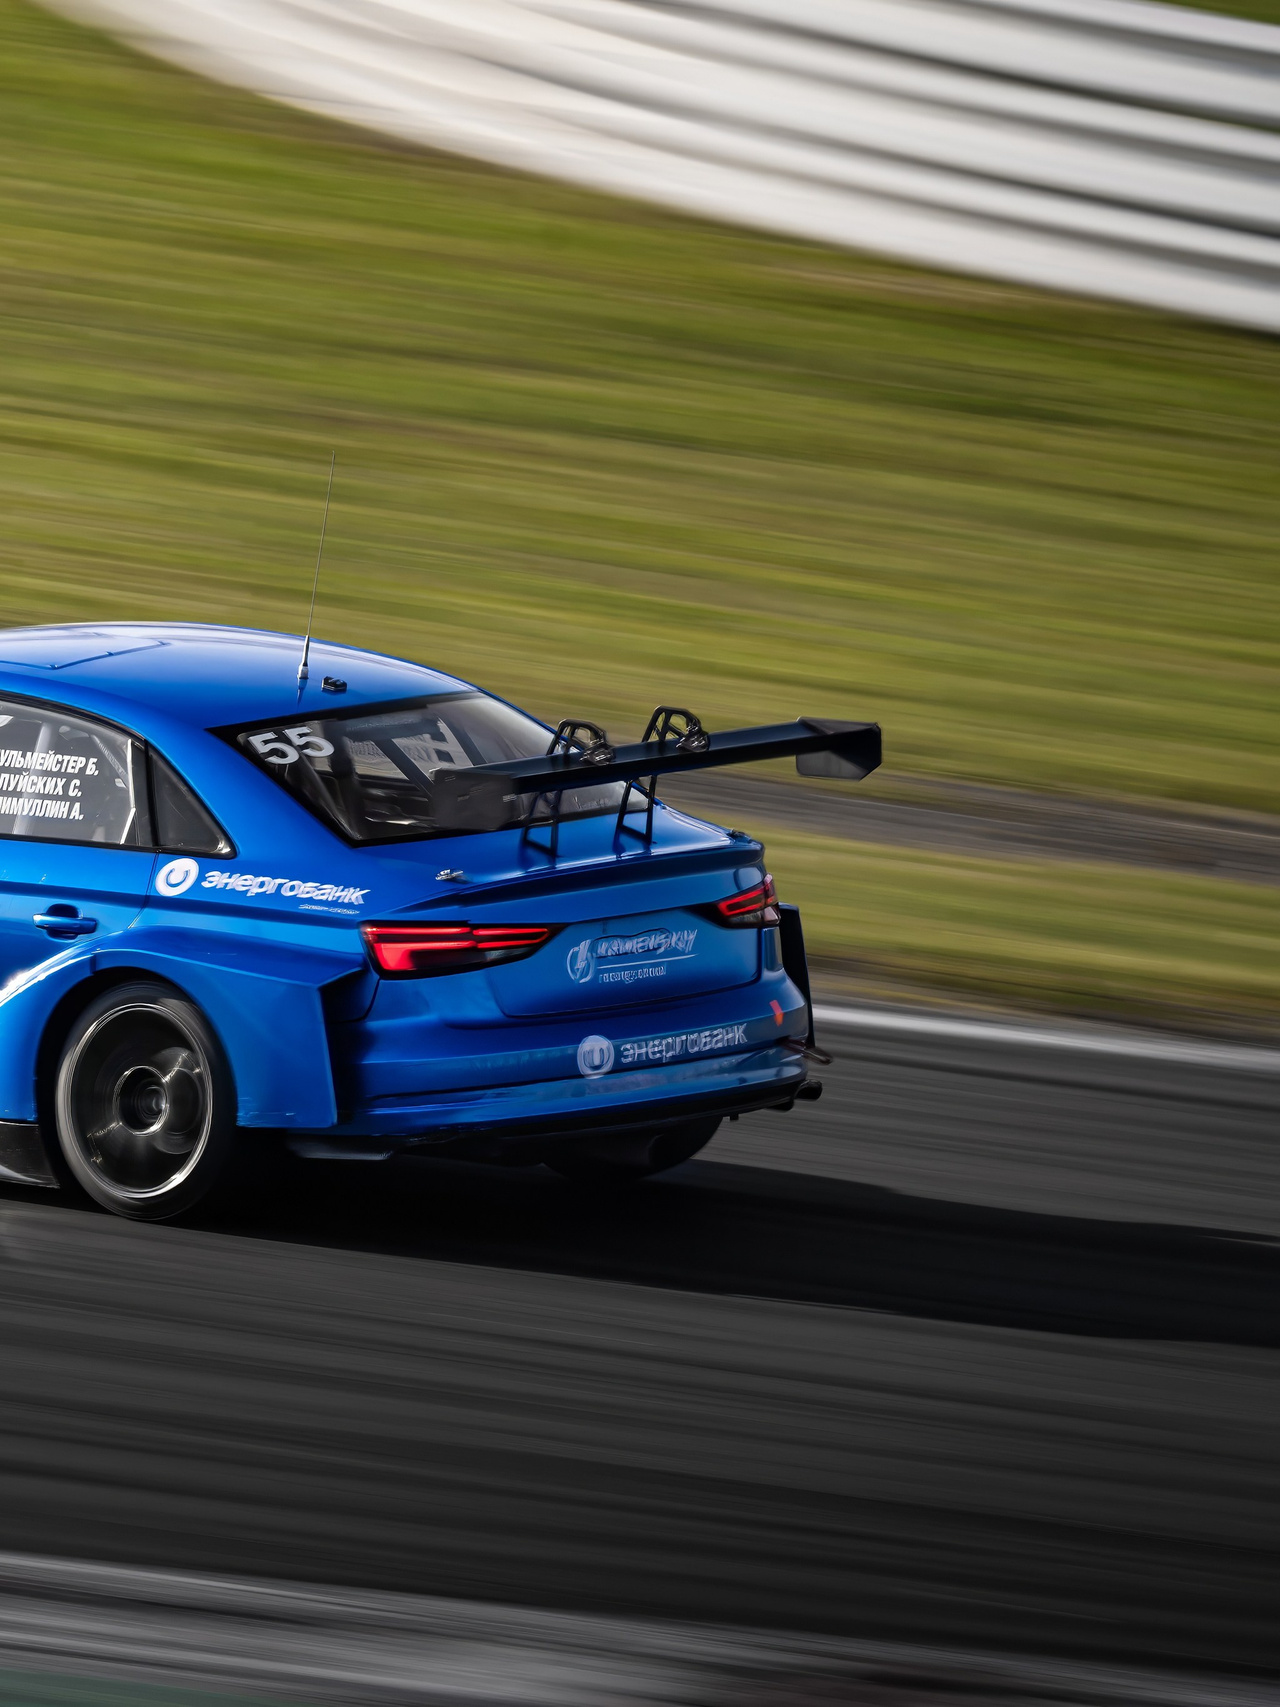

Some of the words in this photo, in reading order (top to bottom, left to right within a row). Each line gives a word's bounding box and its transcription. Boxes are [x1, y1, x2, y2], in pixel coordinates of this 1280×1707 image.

[247, 725, 335, 765] 55
[86, 758, 99, 776] Б.
[68, 779, 82, 798] С.
[69, 802, 84, 820] А.
